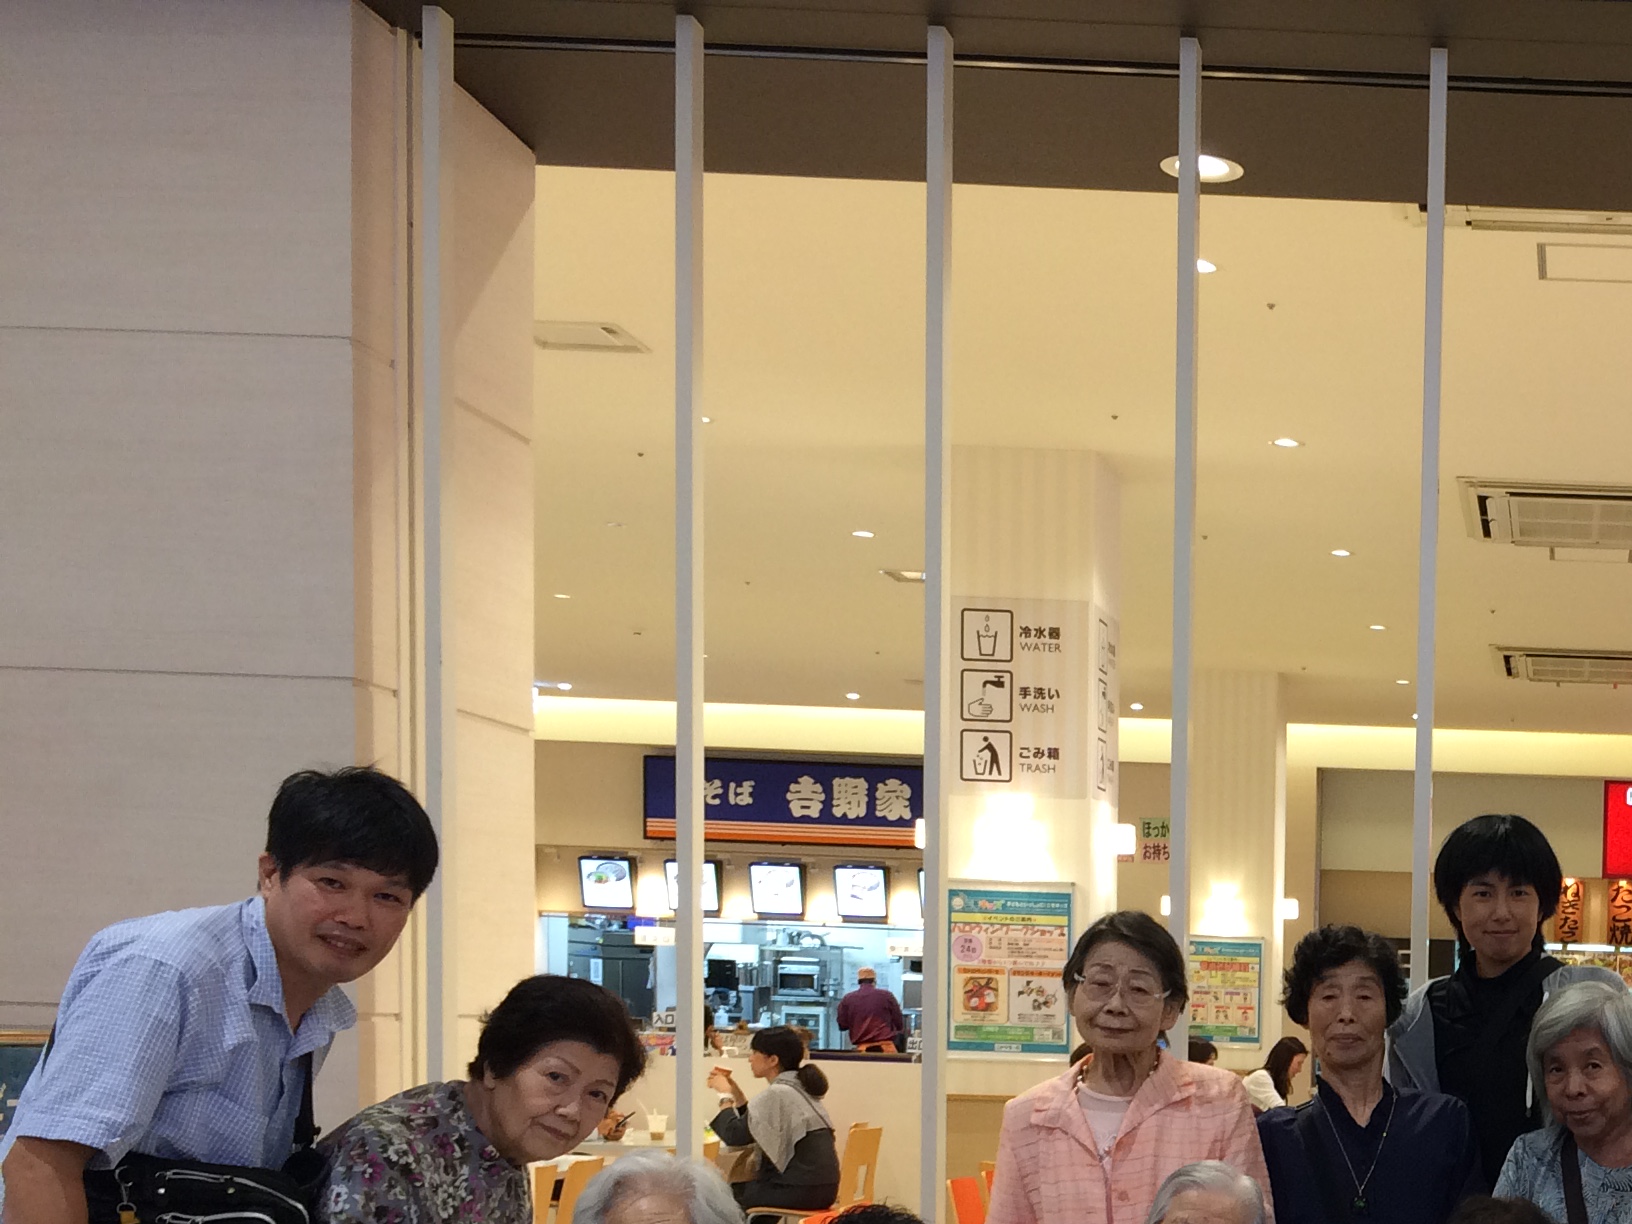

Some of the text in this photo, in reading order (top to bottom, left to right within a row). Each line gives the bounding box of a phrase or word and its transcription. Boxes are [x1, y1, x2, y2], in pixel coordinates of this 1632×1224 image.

[1018, 625, 1061, 640] 冷水器
[1019, 641, 1062, 653] WATER
[1018, 686, 1061, 700] 手洗い
[1019, 702, 1055, 714] WASH
[1018, 746, 1060, 761] ごみ箱
[1019, 762, 1056, 774] TRASH
[653, 1013, 676, 1026] 入口
